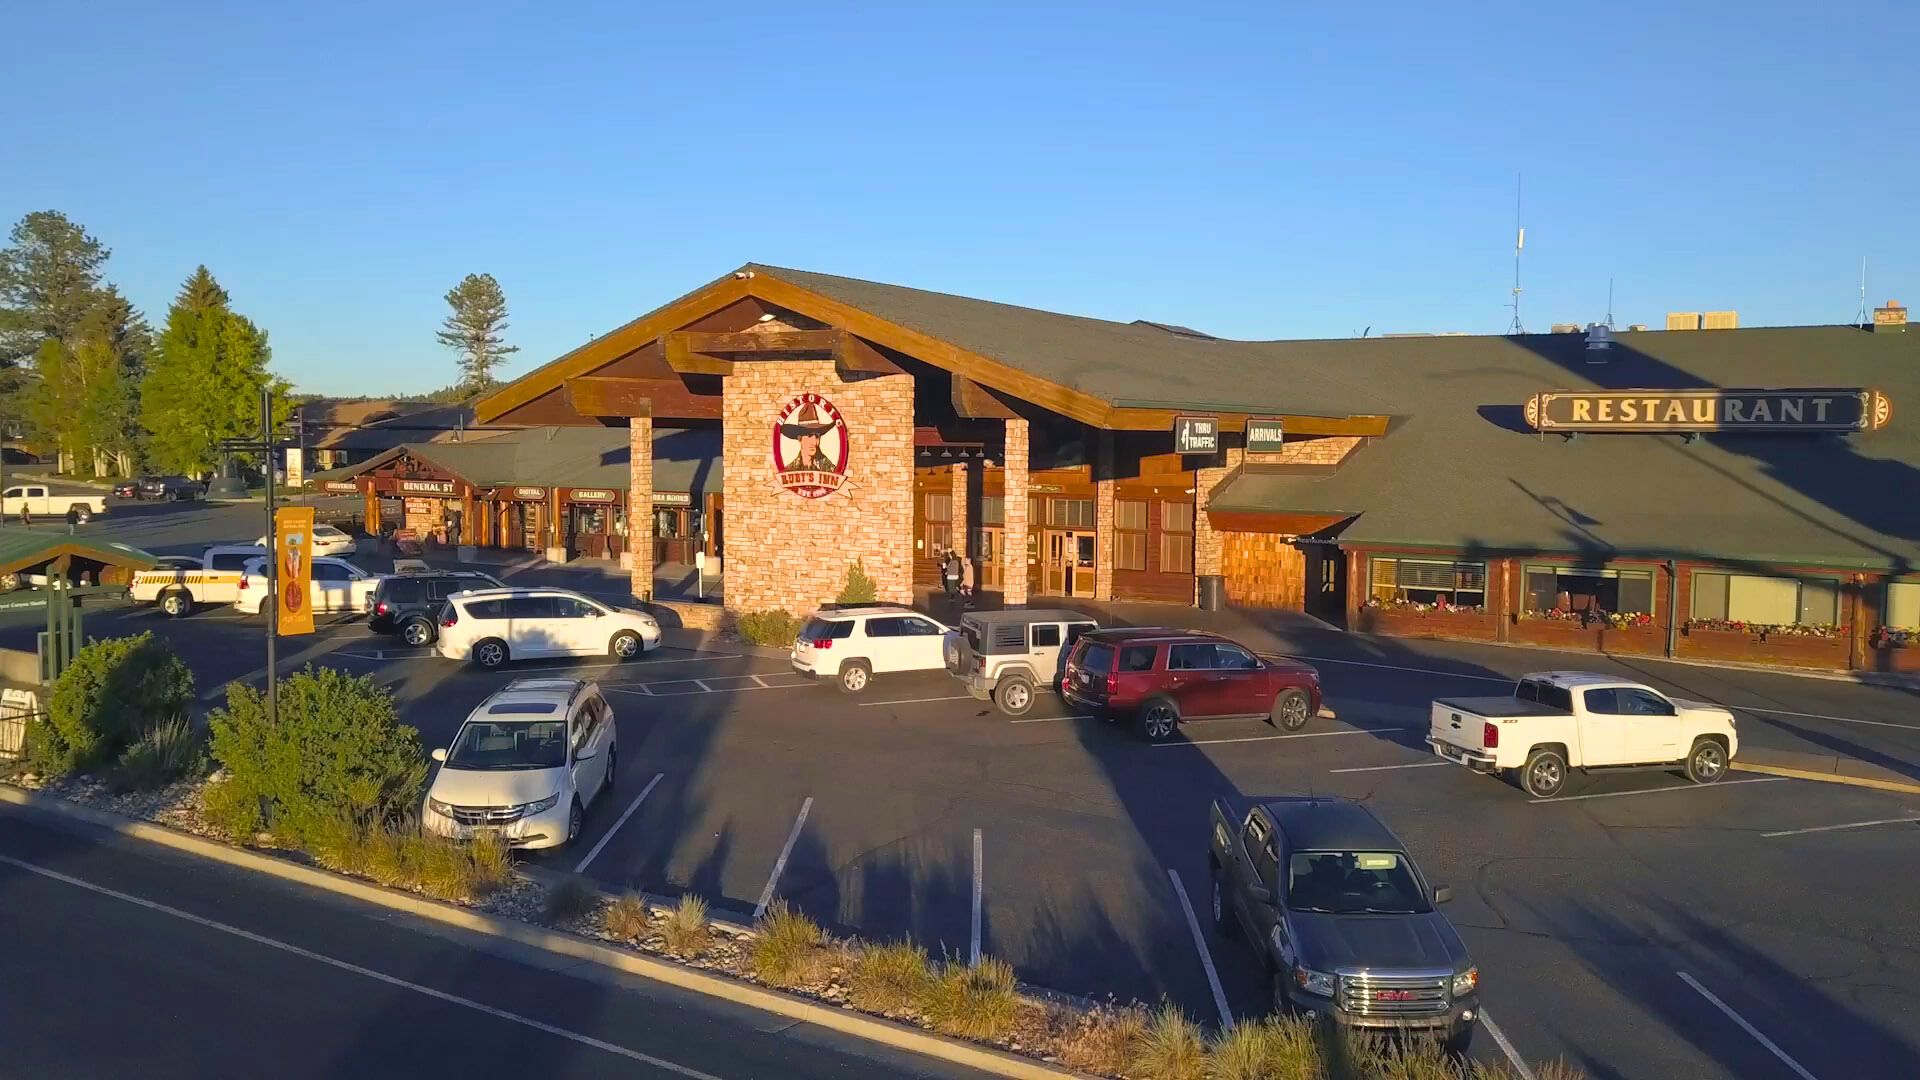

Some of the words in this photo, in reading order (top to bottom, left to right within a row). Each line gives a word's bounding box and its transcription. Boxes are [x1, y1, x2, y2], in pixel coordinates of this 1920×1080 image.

[777, 394, 843, 427] HISTORIC
[1571, 398, 1833, 423] RESTAURANT
[1194, 422, 1212, 434] THRU
[1249, 427, 1282, 442] ARRIVALS
[1189, 436, 1215, 449] TRAFFIC
[780, 472, 814, 485] RUBY'S
[818, 473, 839, 487] INN
[403, 482, 441, 492] GENERAL
[443, 483, 454, 492] ST
[518, 488, 541, 496] DIGITAL
[578, 491, 607, 499] GALLERY
